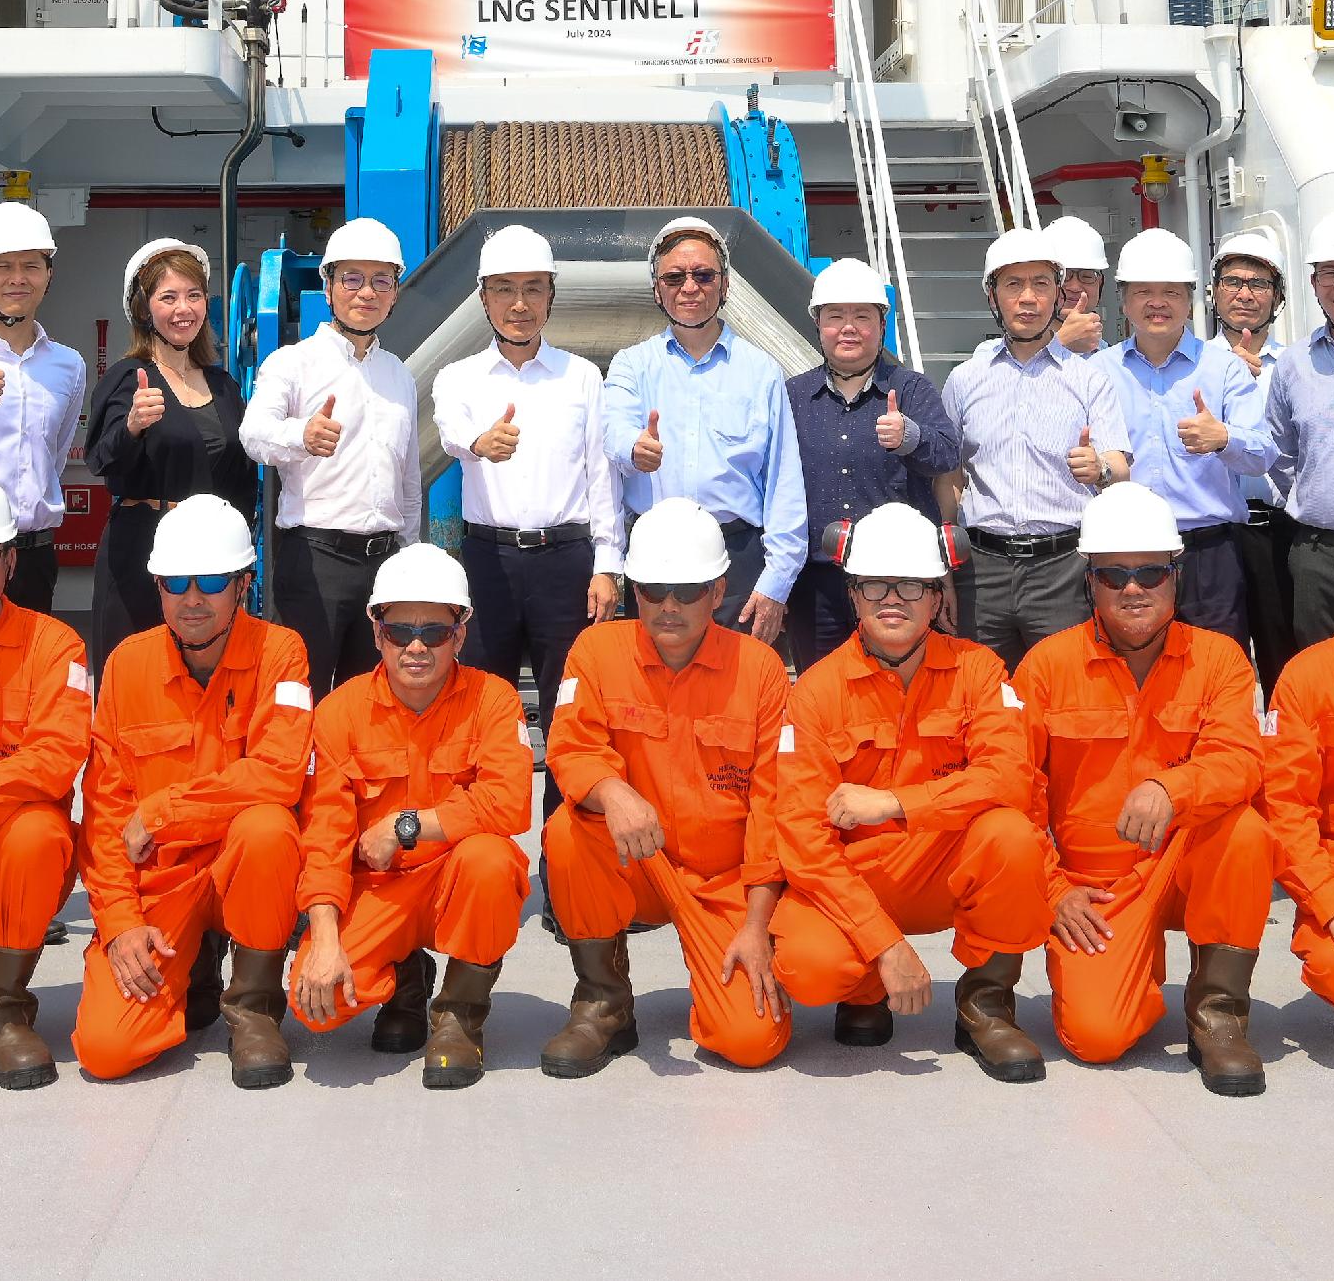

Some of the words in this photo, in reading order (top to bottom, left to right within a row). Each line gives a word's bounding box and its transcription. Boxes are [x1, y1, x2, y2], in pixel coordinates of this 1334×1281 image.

[565, 29, 585, 40] July
[587, 29, 611, 38] 2024
[671, 58, 698, 66] SALVAGE
[733, 57, 761, 65] SERVICES
[762, 56, 773, 64] LTD
[53, 543, 73, 551] FIRE
